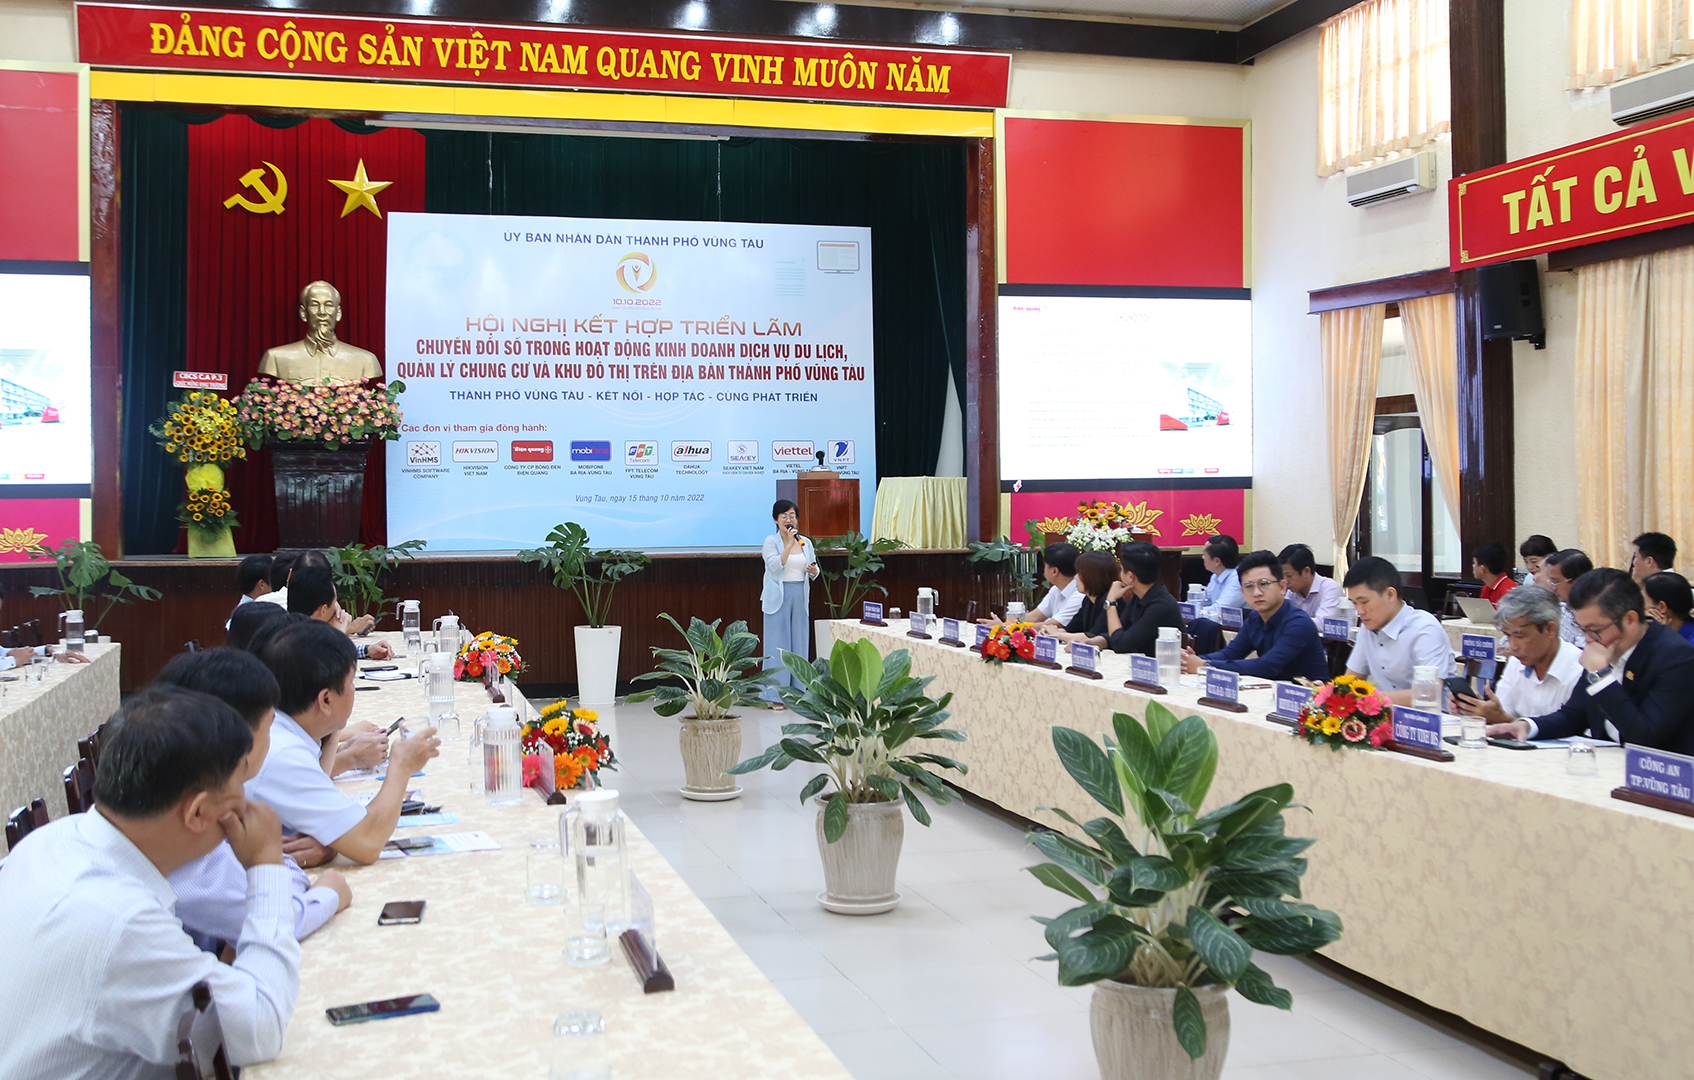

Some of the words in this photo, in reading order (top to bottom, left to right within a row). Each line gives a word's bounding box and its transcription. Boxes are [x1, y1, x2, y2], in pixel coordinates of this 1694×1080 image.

[149, 12, 246, 59] ĐẢNG
[256, 21, 348, 69] CỘNG
[357, 23, 423, 66] SẢN
[431, 31, 512, 77] VIỆT
[520, 42, 588, 75] NAM
[596, 45, 702, 81] QUANG
[711, 52, 785, 85] VINH
[793, 52, 878, 90] MUÔN
[886, 55, 952, 94] NĂM
[1502, 165, 1578, 235] TẤT
[1593, 144, 1658, 214] CẢ
[1672, 146, 1694, 195] V
[525, 233, 552, 243] BAN
[556, 232, 591, 244] NHÂN
[596, 233, 622, 245] DÂN
[626, 233, 669, 246] THÀNH
[673, 234, 699, 247] PHỐ
[702, 235, 737, 248] VŨNG
[612, 298, 662, 306] 10.10.2022
[466, 313, 505, 336] HỘI
[512, 317, 567, 337] NGHỊ
[574, 313, 618, 334] KẾT
[626, 318, 674, 338] HỢP
[680, 315, 746, 336] TRIỂN
[753, 317, 802, 336] LÃM
[416, 336, 471, 355] CHUYỂN
[476, 336, 499, 356] ĐỔI
[504, 337, 522, 356] SỐ
[525, 340, 571, 356] TRONG
[575, 341, 610, 360] HOẠT
[614, 339, 651, 360] ĐỘNG
[655, 342, 687, 358] KINH
[691, 342, 735, 358] DOANH
[740, 343, 770, 361] DỊCH
[774, 344, 790, 362] VỤ
[794, 344, 811, 359] DU
[816, 344, 848, 362] LỊCH,
[397, 359, 435, 379] QUẢN
[440, 360, 455, 378] LÝ
[460, 362, 507, 378] CHUNG
[511, 362, 531, 379] CƯ
[533, 361, 550, 379] VÀ
[555, 363, 582, 379] KHU
[586, 361, 605, 379] ĐÔ
[608, 364, 630, 382] THỊ
[633, 362, 667, 380] TRÊN
[671, 365, 694, 383] ĐỊA
[700, 362, 725, 380] BÀN
[728, 363, 771, 380] THÀNH
[776, 362, 801, 380] PHỐ
[805, 363, 838, 381] VŨNG
[842, 364, 865, 381] TÀU
[450, 388, 493, 400] THÀNH
[495, 388, 521, 400] PHỐ
[524, 388, 558, 401] VŨNG
[561, 389, 584, 401] TÀU
[596, 389, 618, 401] KẾT
[622, 389, 643, 401] NỐI
[655, 391, 679, 403] HỢP
[683, 390, 705, 402] TÁC
[753, 390, 781, 402] PHÁT
[785, 390, 818, 402] TRIỂN
[453, 424, 477, 432] tham
[479, 424, 493, 433] gia
[409, 456, 439, 464] VinHMS
[628, 444, 653, 458] FPT
[774, 447, 813, 455] viettel
[1395, 721, 1410, 739] CÔNG
[1410, 726, 1417, 740] TY
[1639, 756, 1665, 773] CÔNG
[1667, 764, 1680, 777] AN
[1630, 774, 1669, 794] TP.VŨNG
[1670, 783, 1691, 799] TÀU
